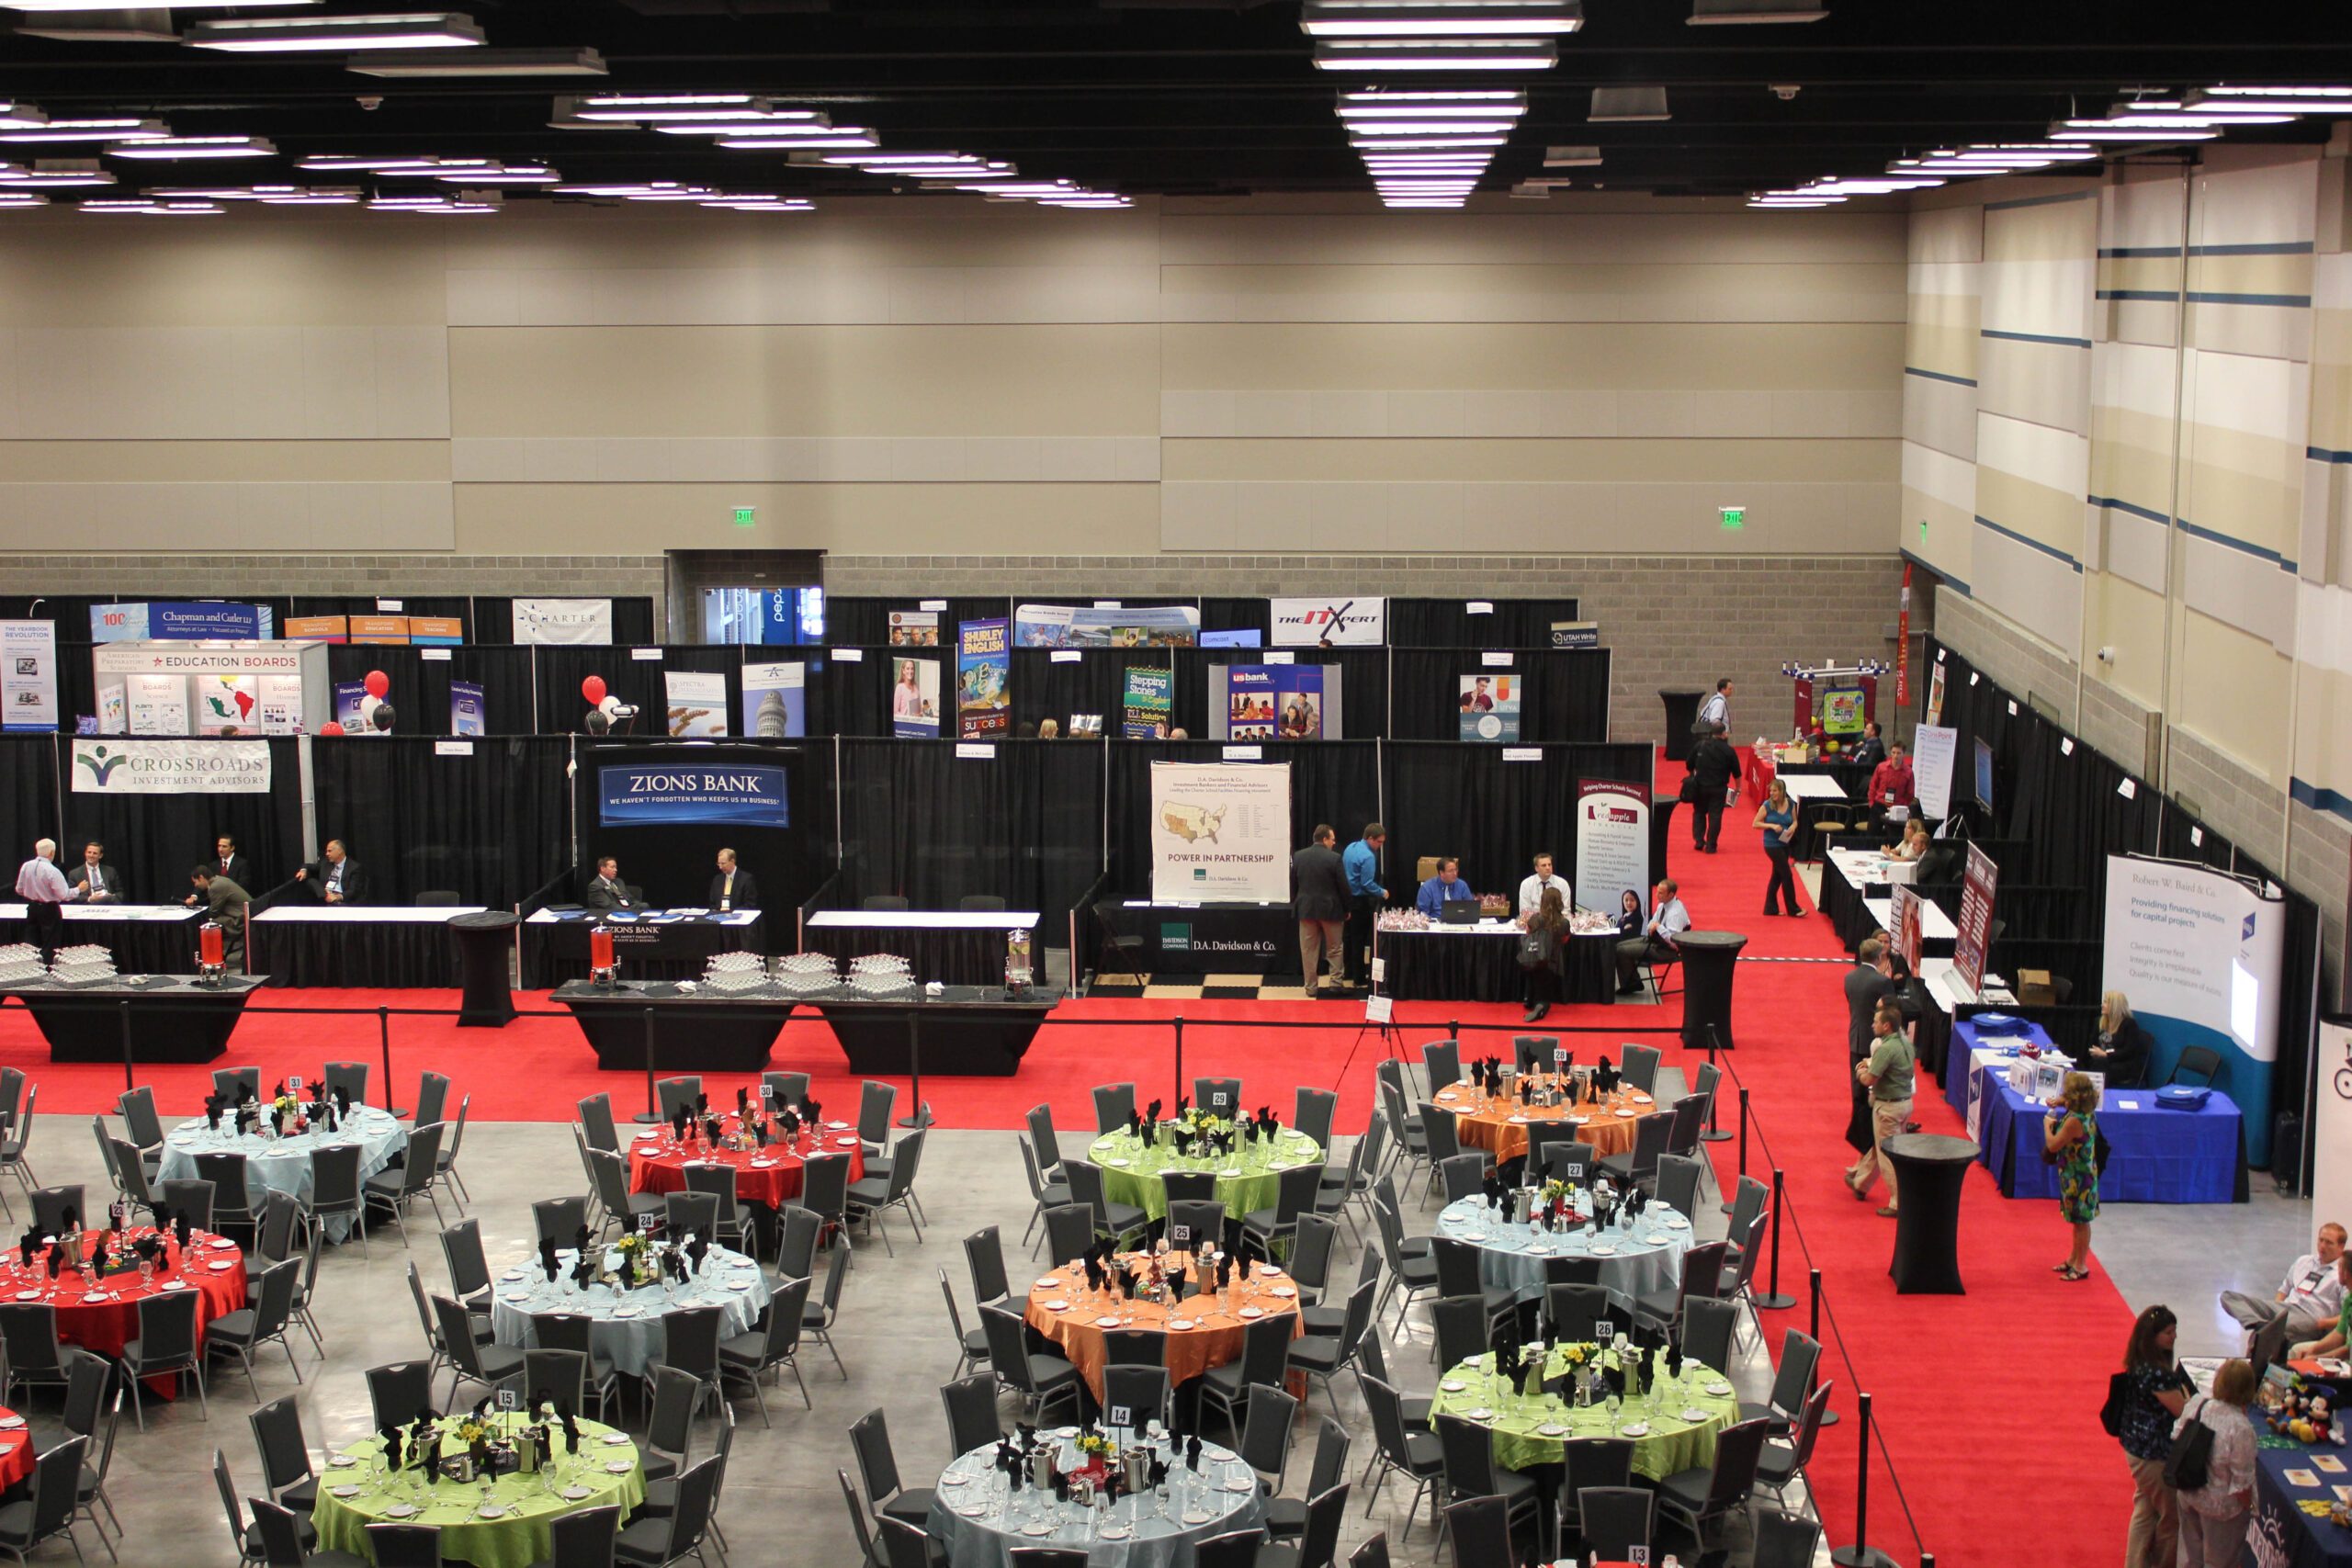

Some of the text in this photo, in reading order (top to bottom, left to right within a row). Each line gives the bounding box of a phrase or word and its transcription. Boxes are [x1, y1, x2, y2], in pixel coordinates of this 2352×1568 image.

[736, 511, 752, 522] EXIT
[1724, 512, 1740, 523] EXIT
[163, 612, 205, 624] Chapman
[206, 613, 220, 622] and
[220, 613, 243, 623] Cutler
[528, 614, 596, 624] CHARTER
[963, 628, 1004, 643] SHURLEY
[963, 640, 1004, 655] ENGLISH
[166, 657, 297, 667] EDUCATION BOARDS
[1130, 674, 1167, 689] Stepping
[339, 686, 364, 694] Financing
[1129, 684, 1157, 696] Stones
[1141, 712, 1167, 722] Solution
[965, 717, 1005, 731] success
[130, 757, 264, 773] CROSSROADS
[133, 775, 266, 784] INVESTMENT ADVISORS
[629, 774, 762, 794] ZIONS BANK
[1583, 784, 1599, 793] Helping
[1612, 784, 1626, 792] Schools
[1168, 853, 1274, 863] POWER IN PARTNERSHIP
[2132, 874, 2158, 886] Robert
[2162, 877, 2173, 888] W.
[2176, 880, 2196, 893] Baird
[2197, 885, 2204, 894] &
[2131, 897, 2225, 924] Providing financing solutions
[2131, 909, 2196, 928] for capital projects
[636, 926, 659, 934] BANK
[1193, 941, 1276, 951] D.A. Davidson & Co.
[2130, 942, 2153, 953] Clients
[2154, 947, 2173, 955] come
[2129, 955, 2157, 968] Integrity
[2129, 968, 2154, 981] Quality
[1555, 1050, 1565, 1059] 28
[290, 1077, 300, 1088] 31
[761, 1086, 771, 1096] 30
[1215, 1094, 1225, 1103] 29
[1571, 1166, 1580, 1175] 27
[114, 1206, 123, 1214] 23
[640, 1215, 651, 1226] 24
[1177, 1227, 1187, 1237] 25
[1598, 1324, 1611, 1335] 26
[504, 1393, 512, 1404] 15
[1115, 1409, 1126, 1421] 14
[1633, 1548, 1645, 1561] 13
